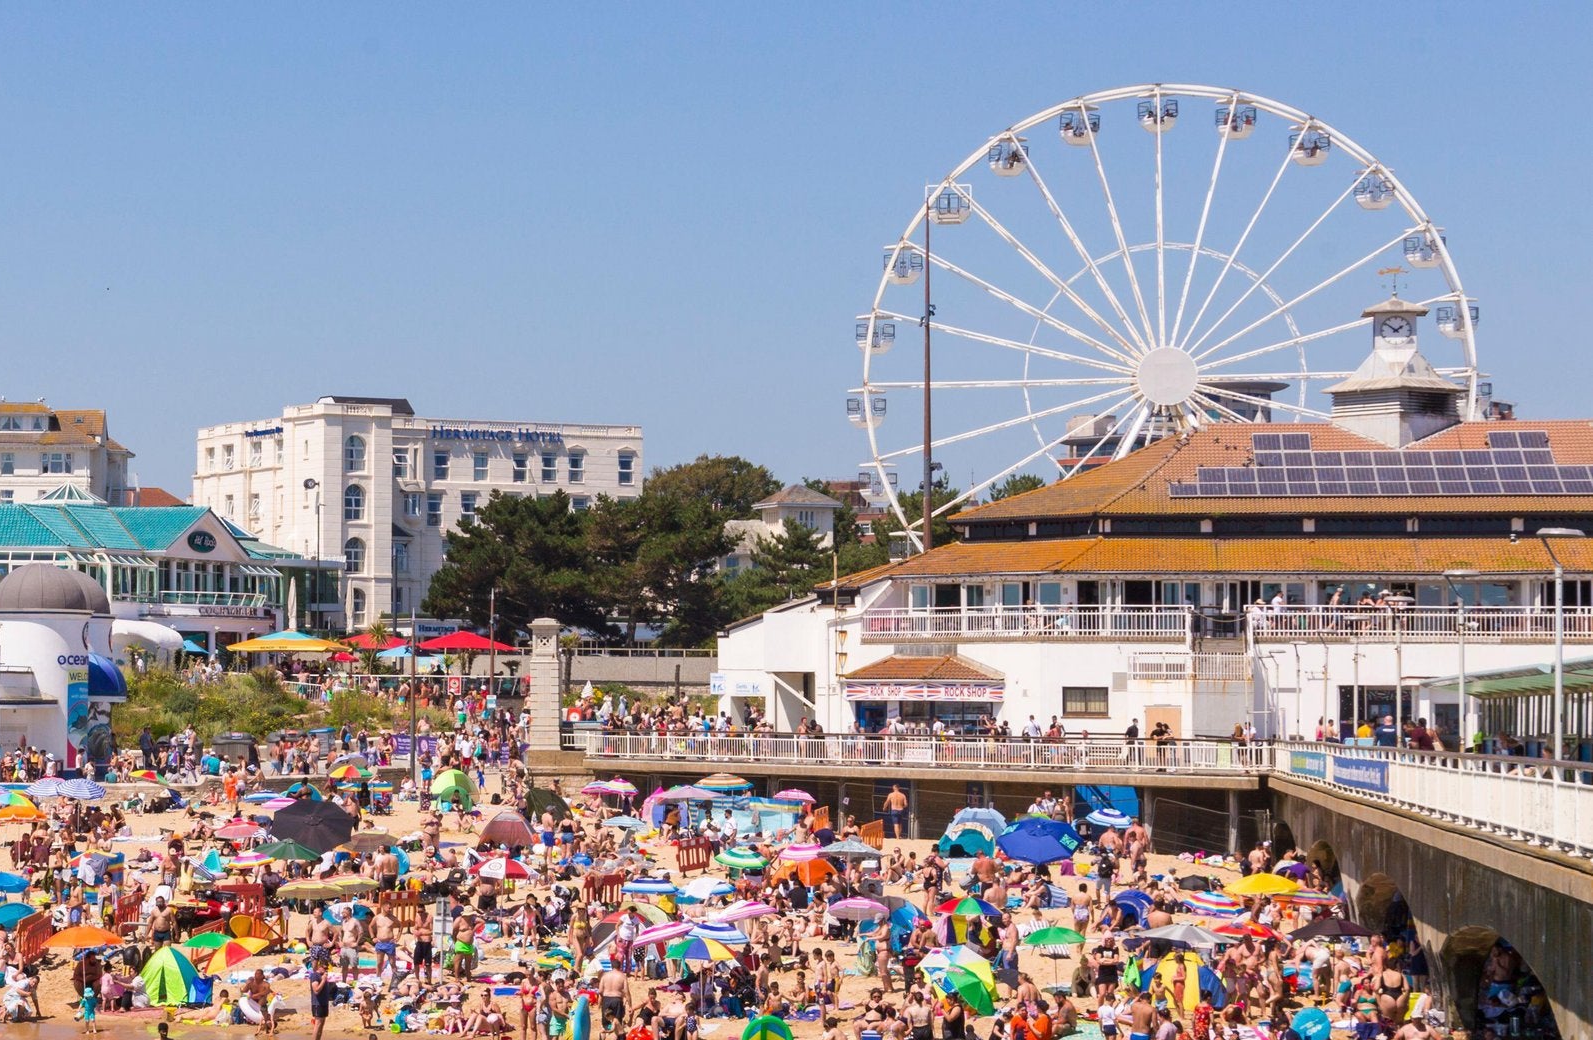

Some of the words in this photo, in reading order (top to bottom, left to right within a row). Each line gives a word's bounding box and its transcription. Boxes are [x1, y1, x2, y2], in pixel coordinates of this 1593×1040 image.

[431, 425, 512, 441] HERMITAGE
[518, 428, 563, 443] HOTEL
[870, 686, 884, 697] ROCK
[887, 686, 902, 697] SHOP
[944, 687, 964, 697] ROCK
[967, 687, 987, 698] SHOP
